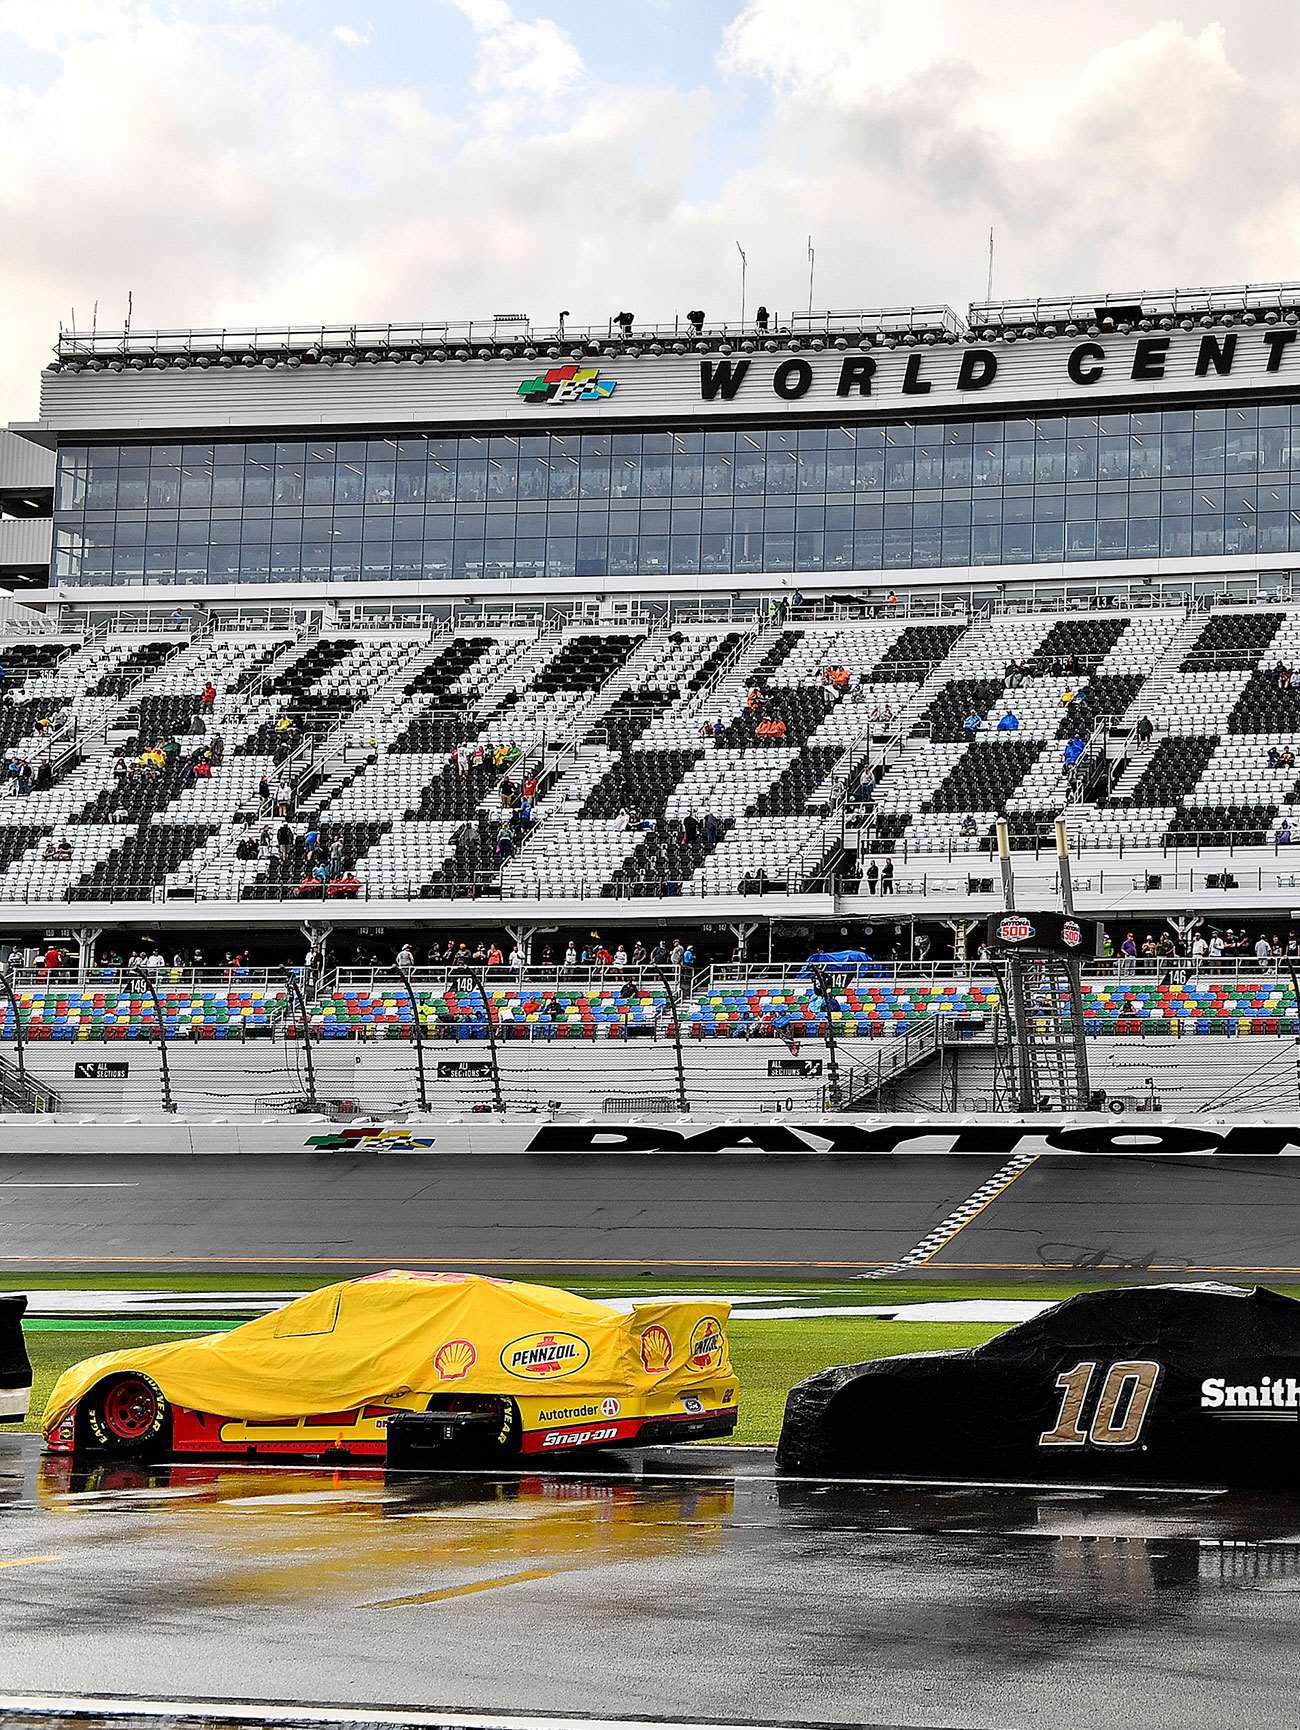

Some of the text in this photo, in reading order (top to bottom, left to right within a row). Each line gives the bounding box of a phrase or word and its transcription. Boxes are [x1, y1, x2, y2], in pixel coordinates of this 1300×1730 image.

[699, 349, 998, 400] WORLD
[1097, 597, 1107, 608] L3
[864, 607, 874, 617] L4
[1003, 927, 1028, 936] 500
[1064, 931, 1079, 941] 500
[831, 974, 847, 987] 147
[1169, 970, 1186, 984] 146
[131, 980, 147, 993] 149
[457, 978, 473, 991] 148
[512, 1344, 580, 1367] PENNZOIL
[1038, 1360, 1160, 1446] 10
[538, 1405, 599, 1421] Autotrader
[89, 1409, 108, 1443] EAGLE
[542, 1427, 618, 1446] Snap-on
